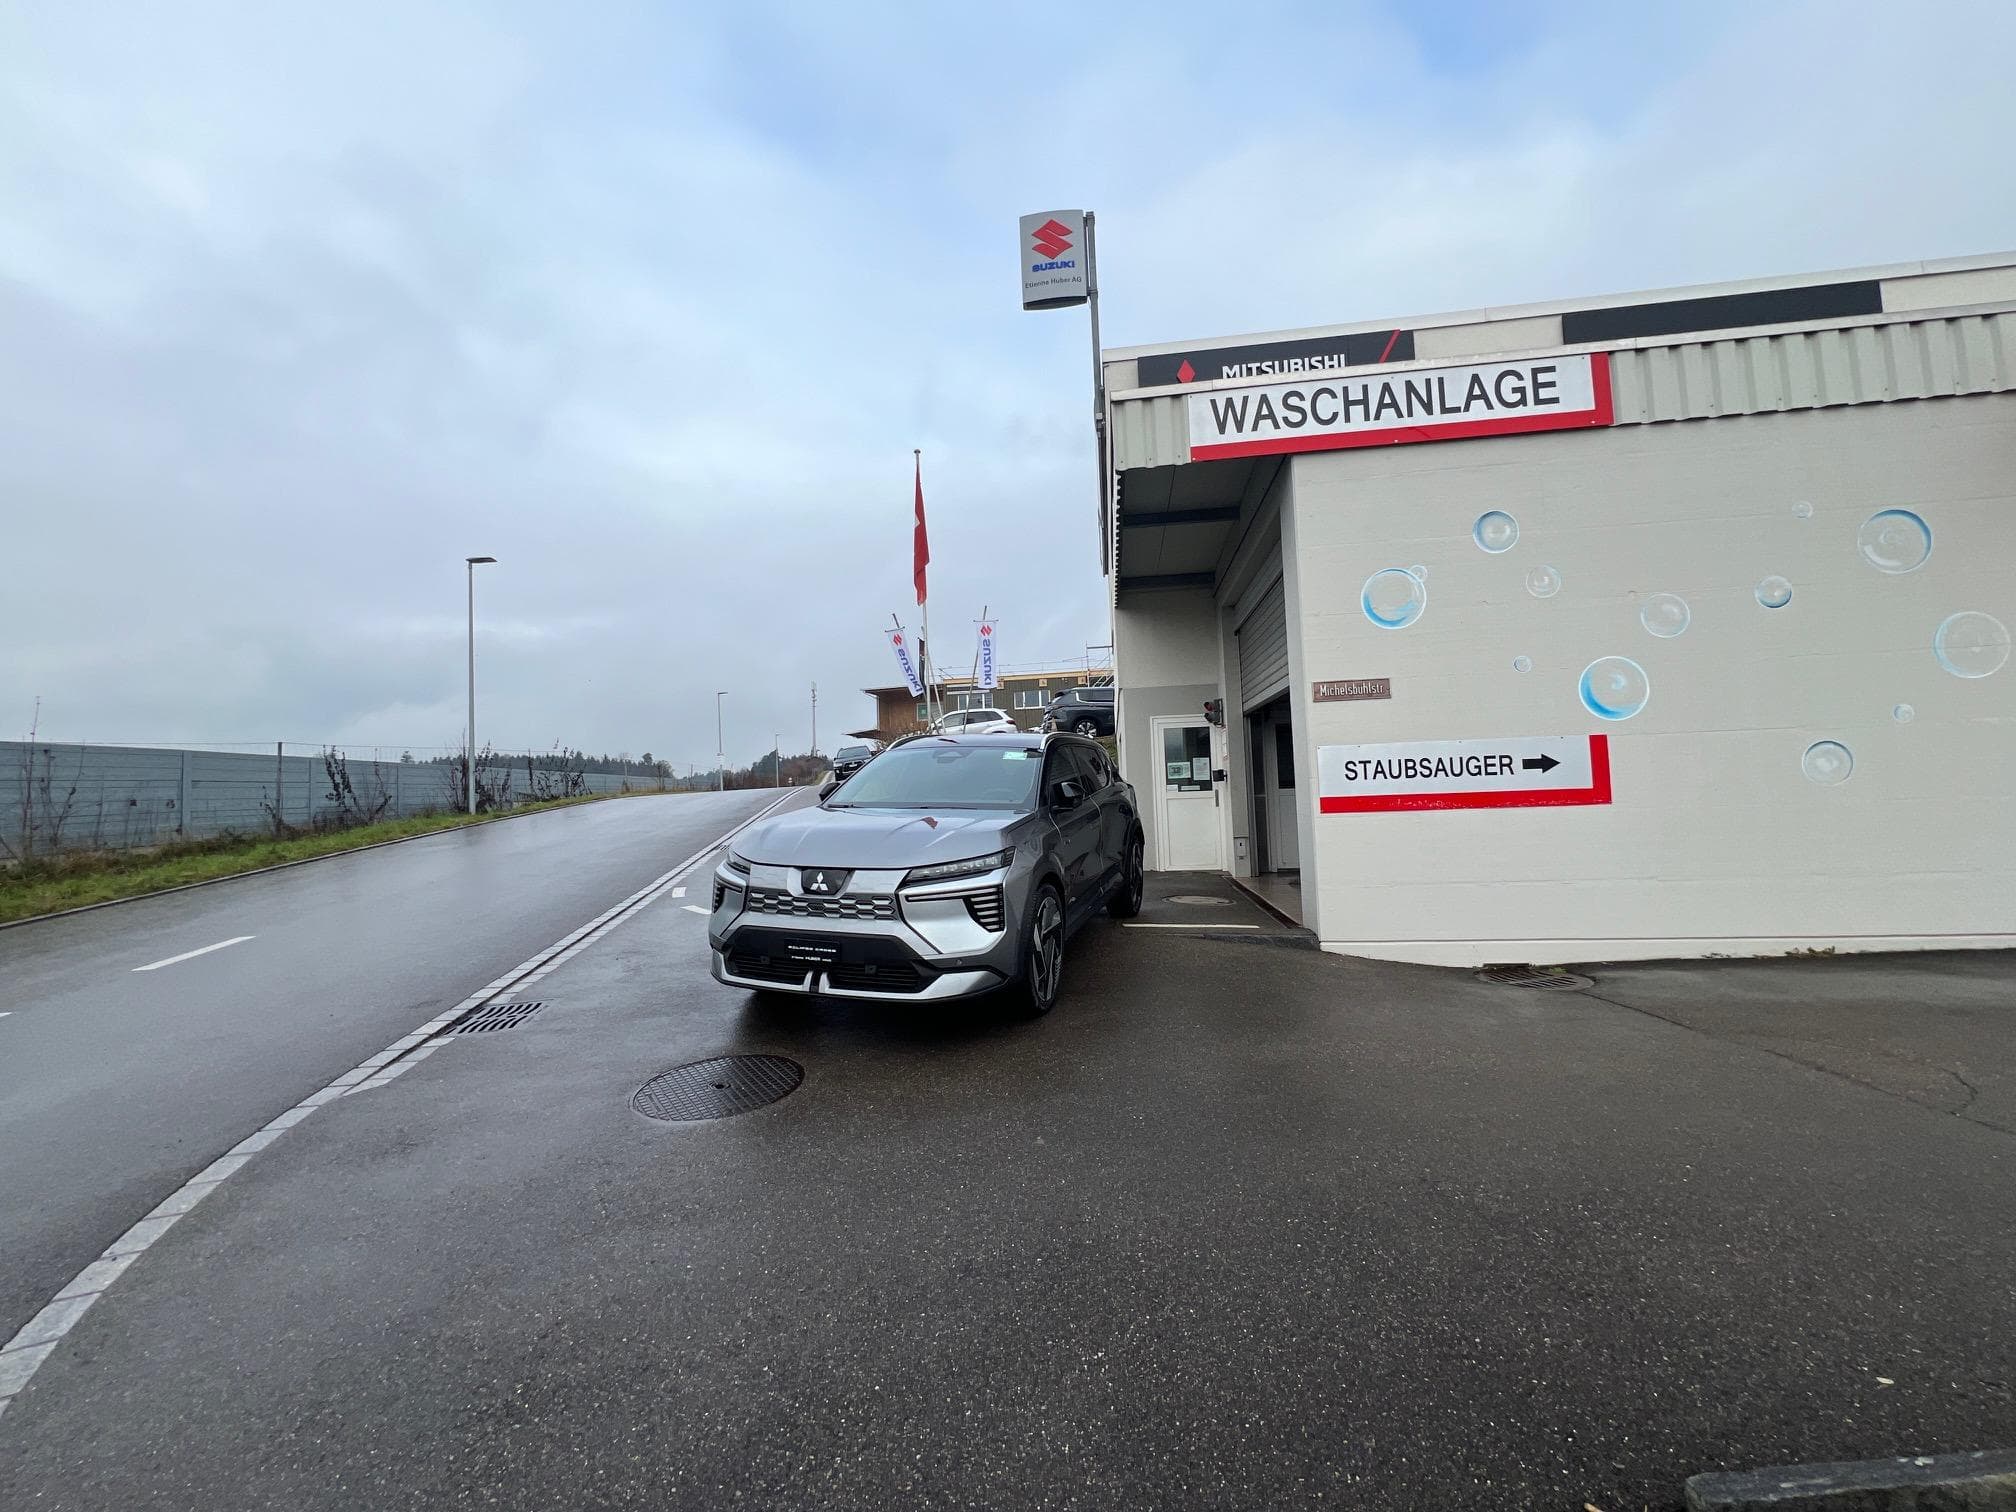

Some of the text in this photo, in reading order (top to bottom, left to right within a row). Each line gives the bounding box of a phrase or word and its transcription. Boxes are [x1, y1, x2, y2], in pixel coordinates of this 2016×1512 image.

[1032, 260, 1075, 272] SUZUKI
[1222, 353, 1346, 380] MITSUBISHI
[1210, 365, 1561, 436] WASCHANLAGE
[1344, 754, 1515, 781] STAUBSAUGER
